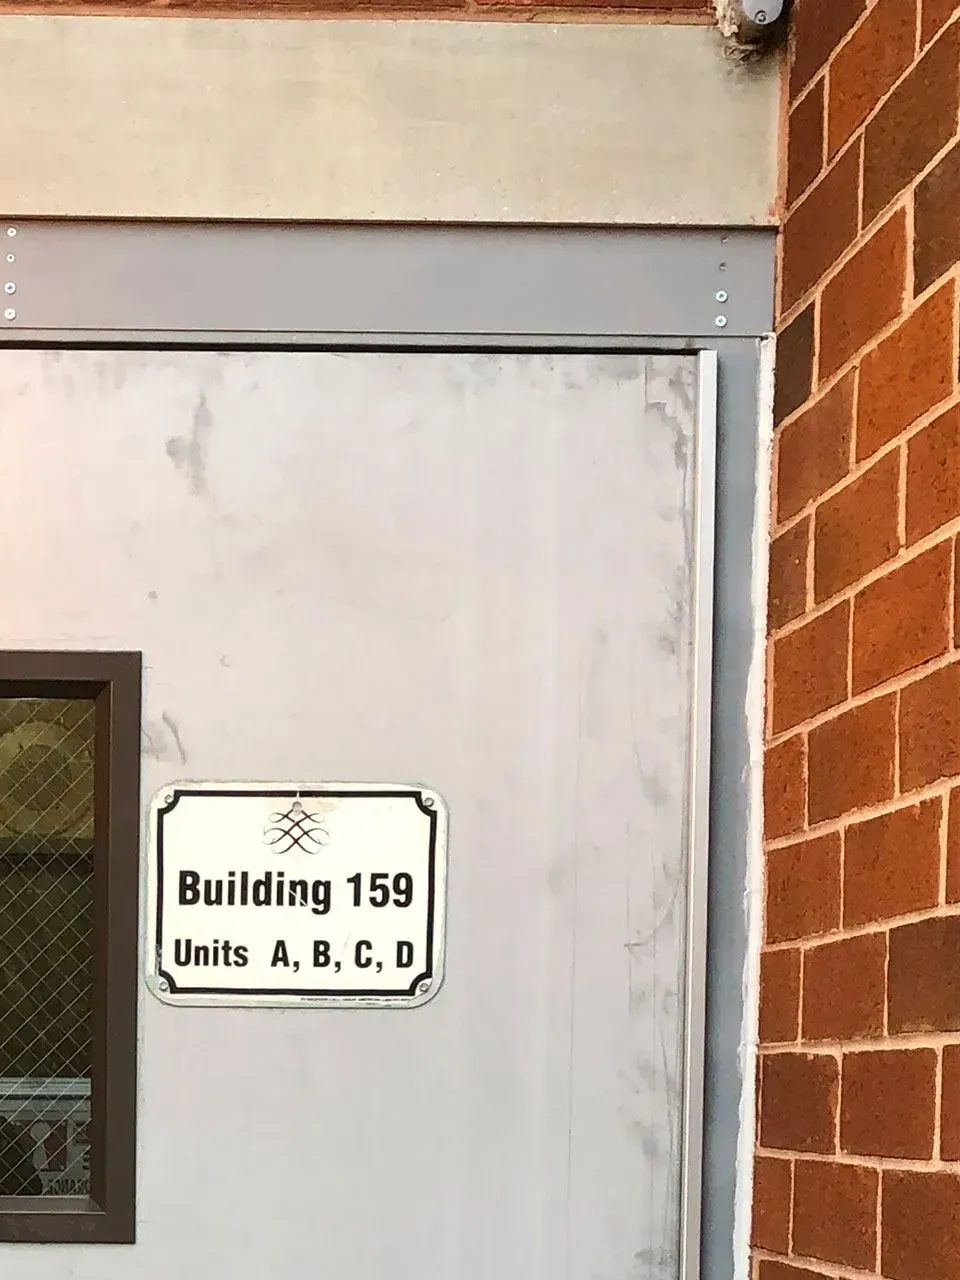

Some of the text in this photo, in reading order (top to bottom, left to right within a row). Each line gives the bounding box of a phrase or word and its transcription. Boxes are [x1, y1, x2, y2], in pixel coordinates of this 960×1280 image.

[178, 870, 414, 915] Building 159
[174, 938, 414, 973] Units A, B, C, D
